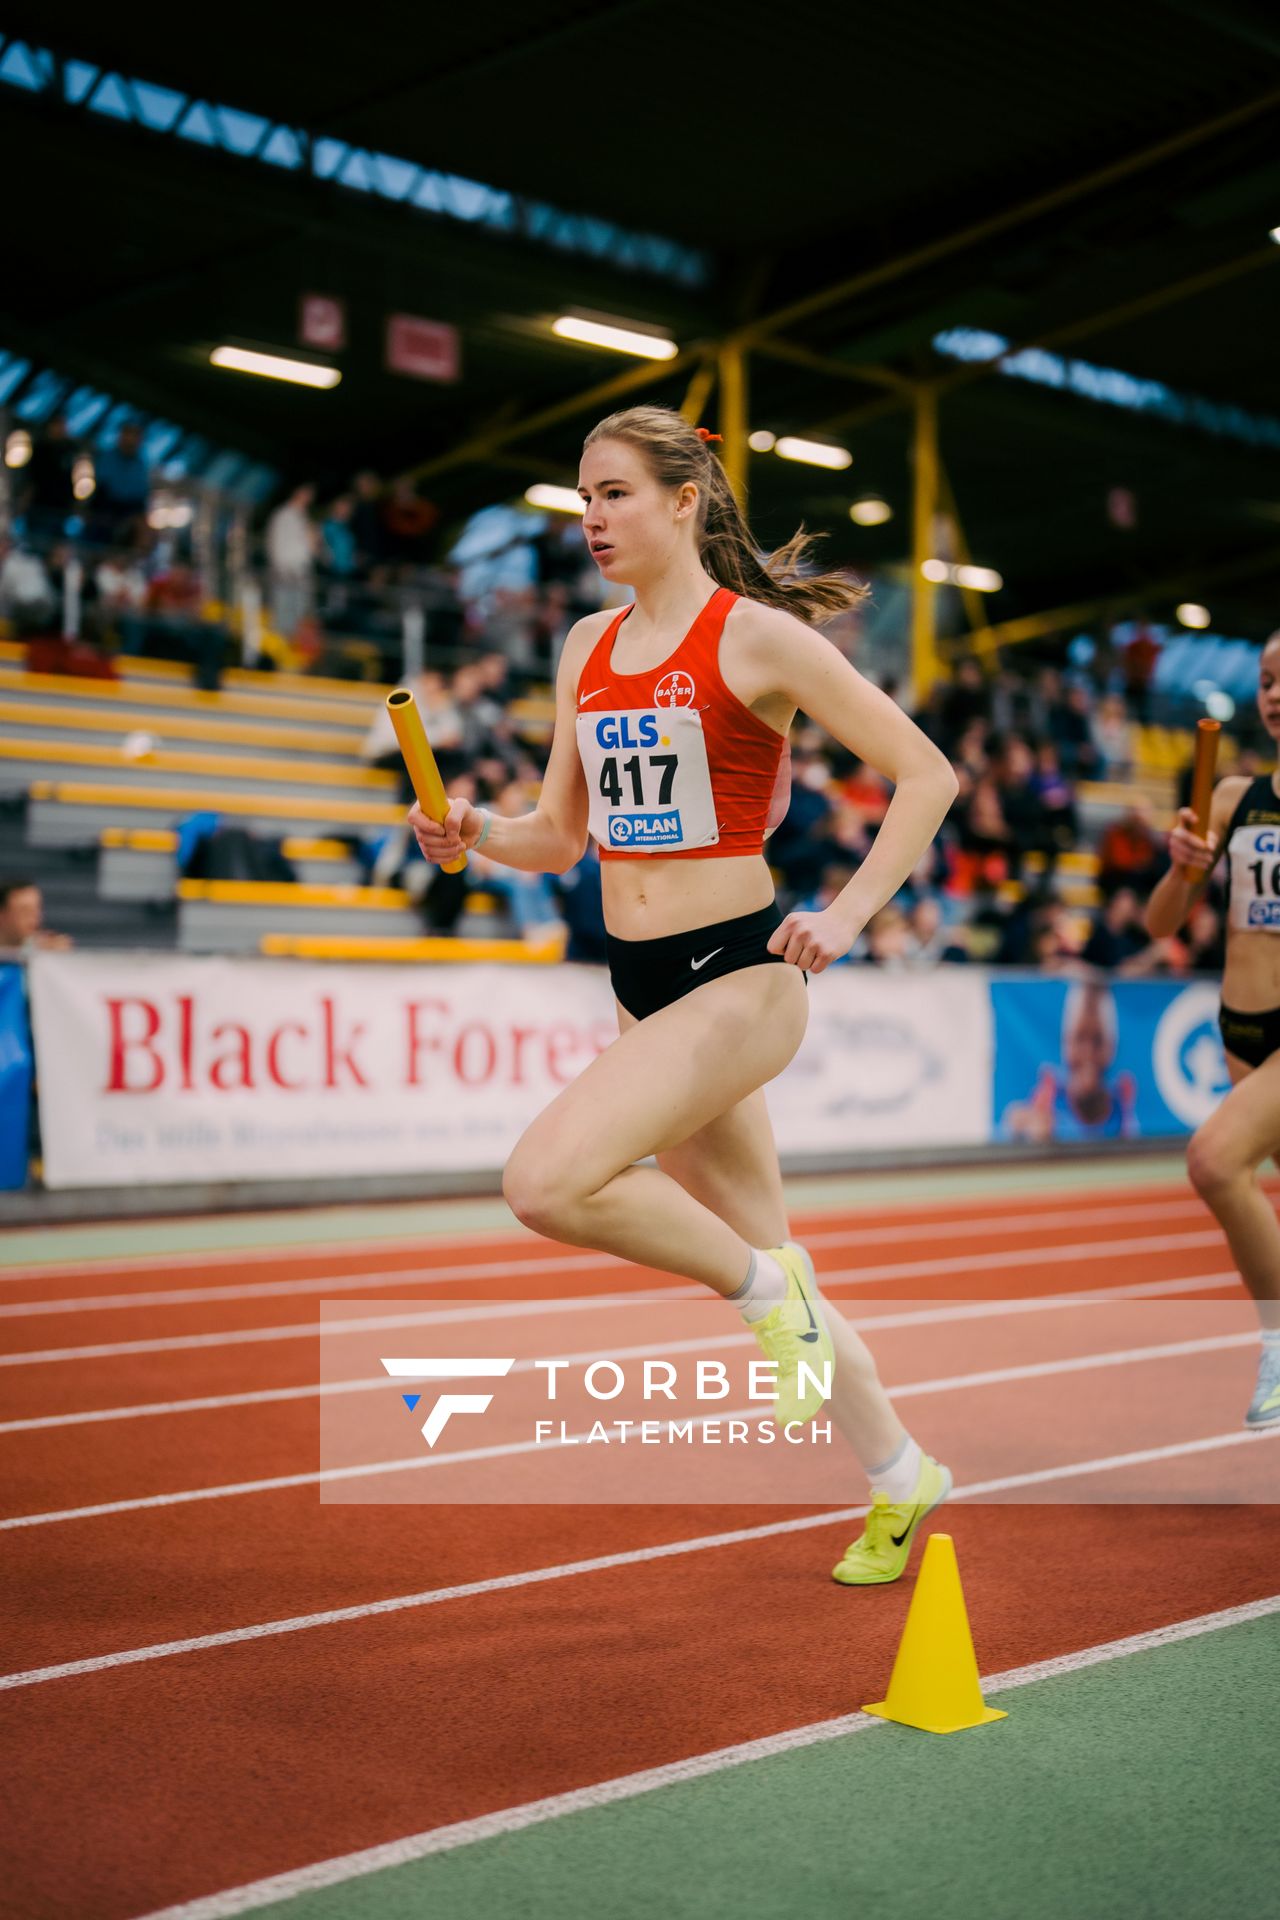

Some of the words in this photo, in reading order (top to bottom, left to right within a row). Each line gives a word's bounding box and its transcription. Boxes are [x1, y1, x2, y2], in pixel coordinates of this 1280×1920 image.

[657, 687, 692, 697] BAYER
[599, 754, 679, 806] 417
[633, 818, 679, 834] PLAN
[635, 833, 679, 842] INTERNATIONAL
[1254, 831, 1280, 853] G
[103, 994, 372, 1094] Black
